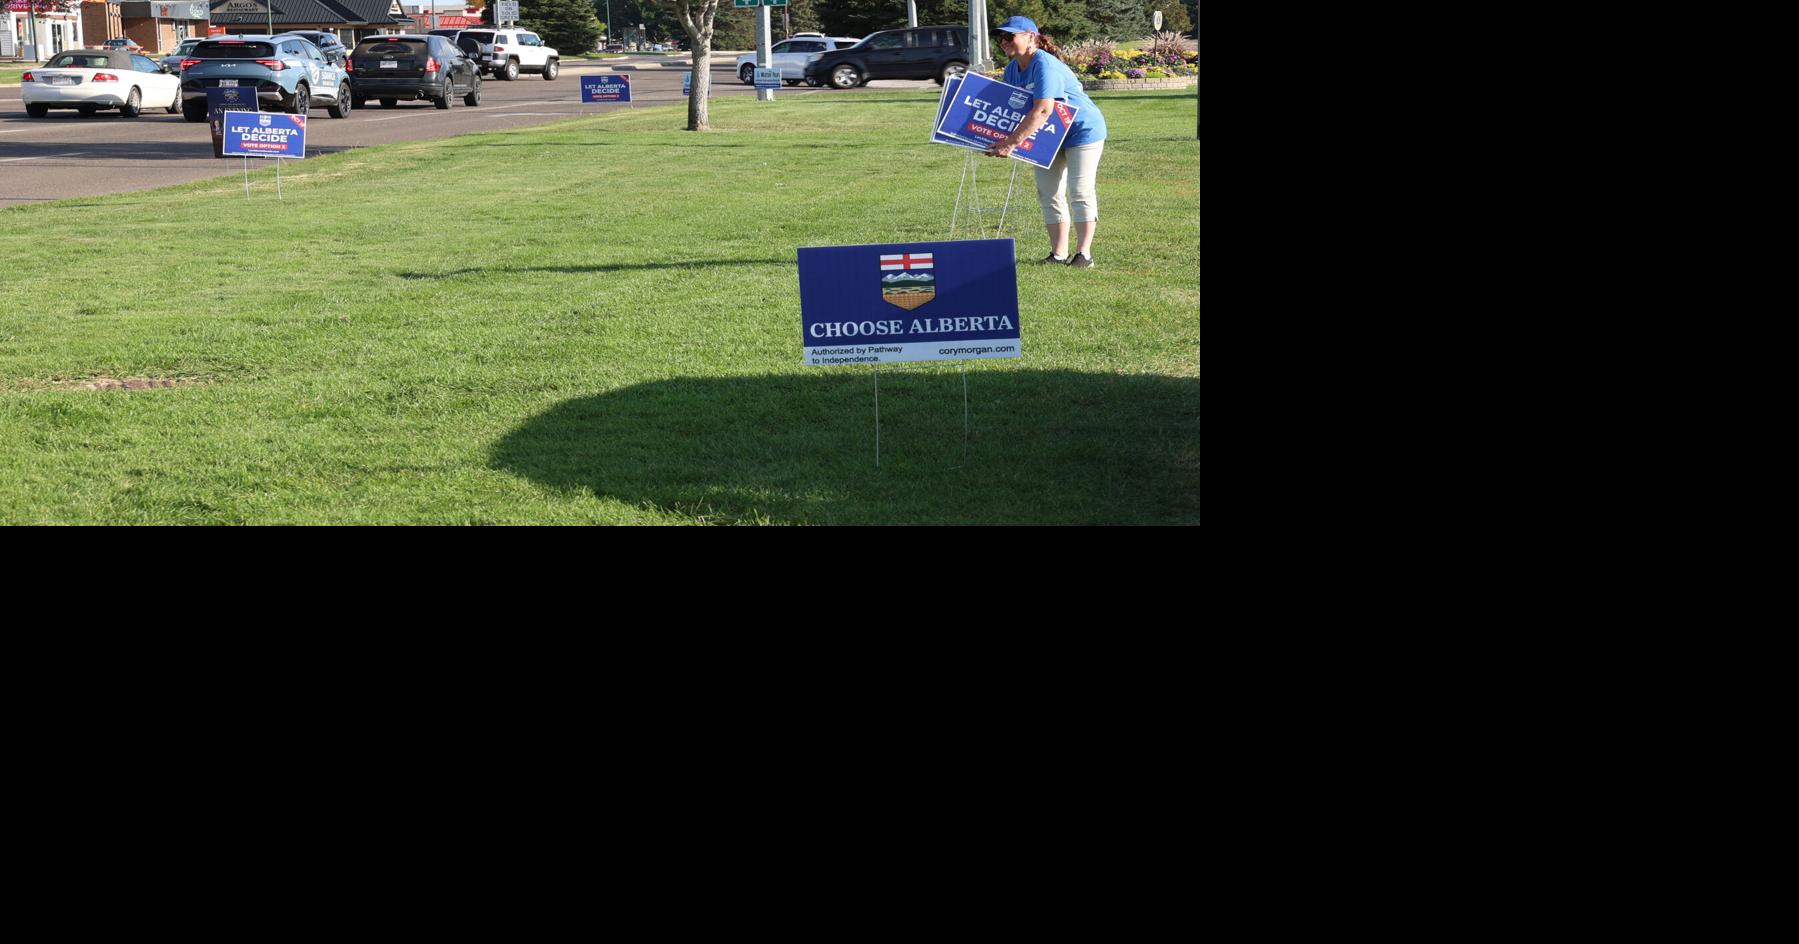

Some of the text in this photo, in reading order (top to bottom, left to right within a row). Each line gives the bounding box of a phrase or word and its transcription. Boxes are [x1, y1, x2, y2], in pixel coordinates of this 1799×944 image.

[963, 95, 991, 111] LET
[1057, 103, 1068, 116] OCT
[251, 127, 299, 136] ALBERTA
[971, 124, 992, 137] VOTE
[241, 133, 288, 143] DECIDE
[810, 315, 1014, 338] CHOOSE ALBERTA
[811, 346, 903, 356] Authorized by Pathway
[939, 345, 1015, 356] corymorgan.com
[822, 356, 881, 365] Independence.
